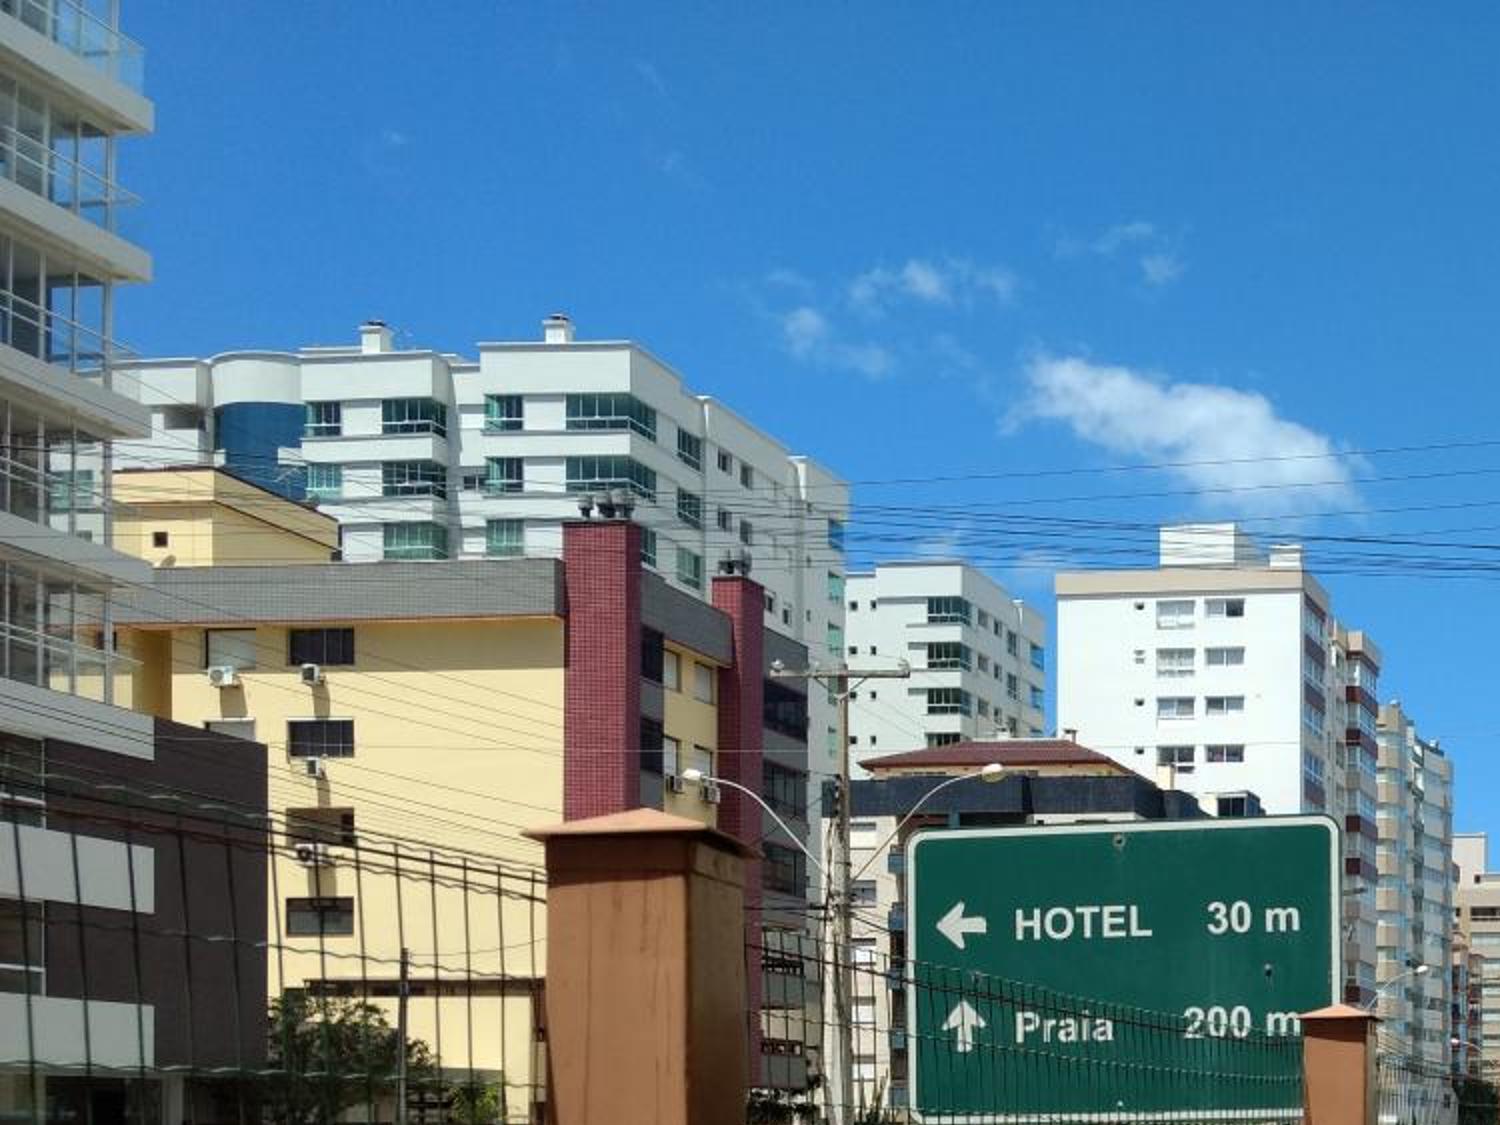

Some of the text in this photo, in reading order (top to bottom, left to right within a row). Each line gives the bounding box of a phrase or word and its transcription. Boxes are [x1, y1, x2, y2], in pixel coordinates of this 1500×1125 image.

[1014, 900, 1300, 941] HOTEL 30 m
[1014, 1004, 1301, 1044] Praia 200 m
